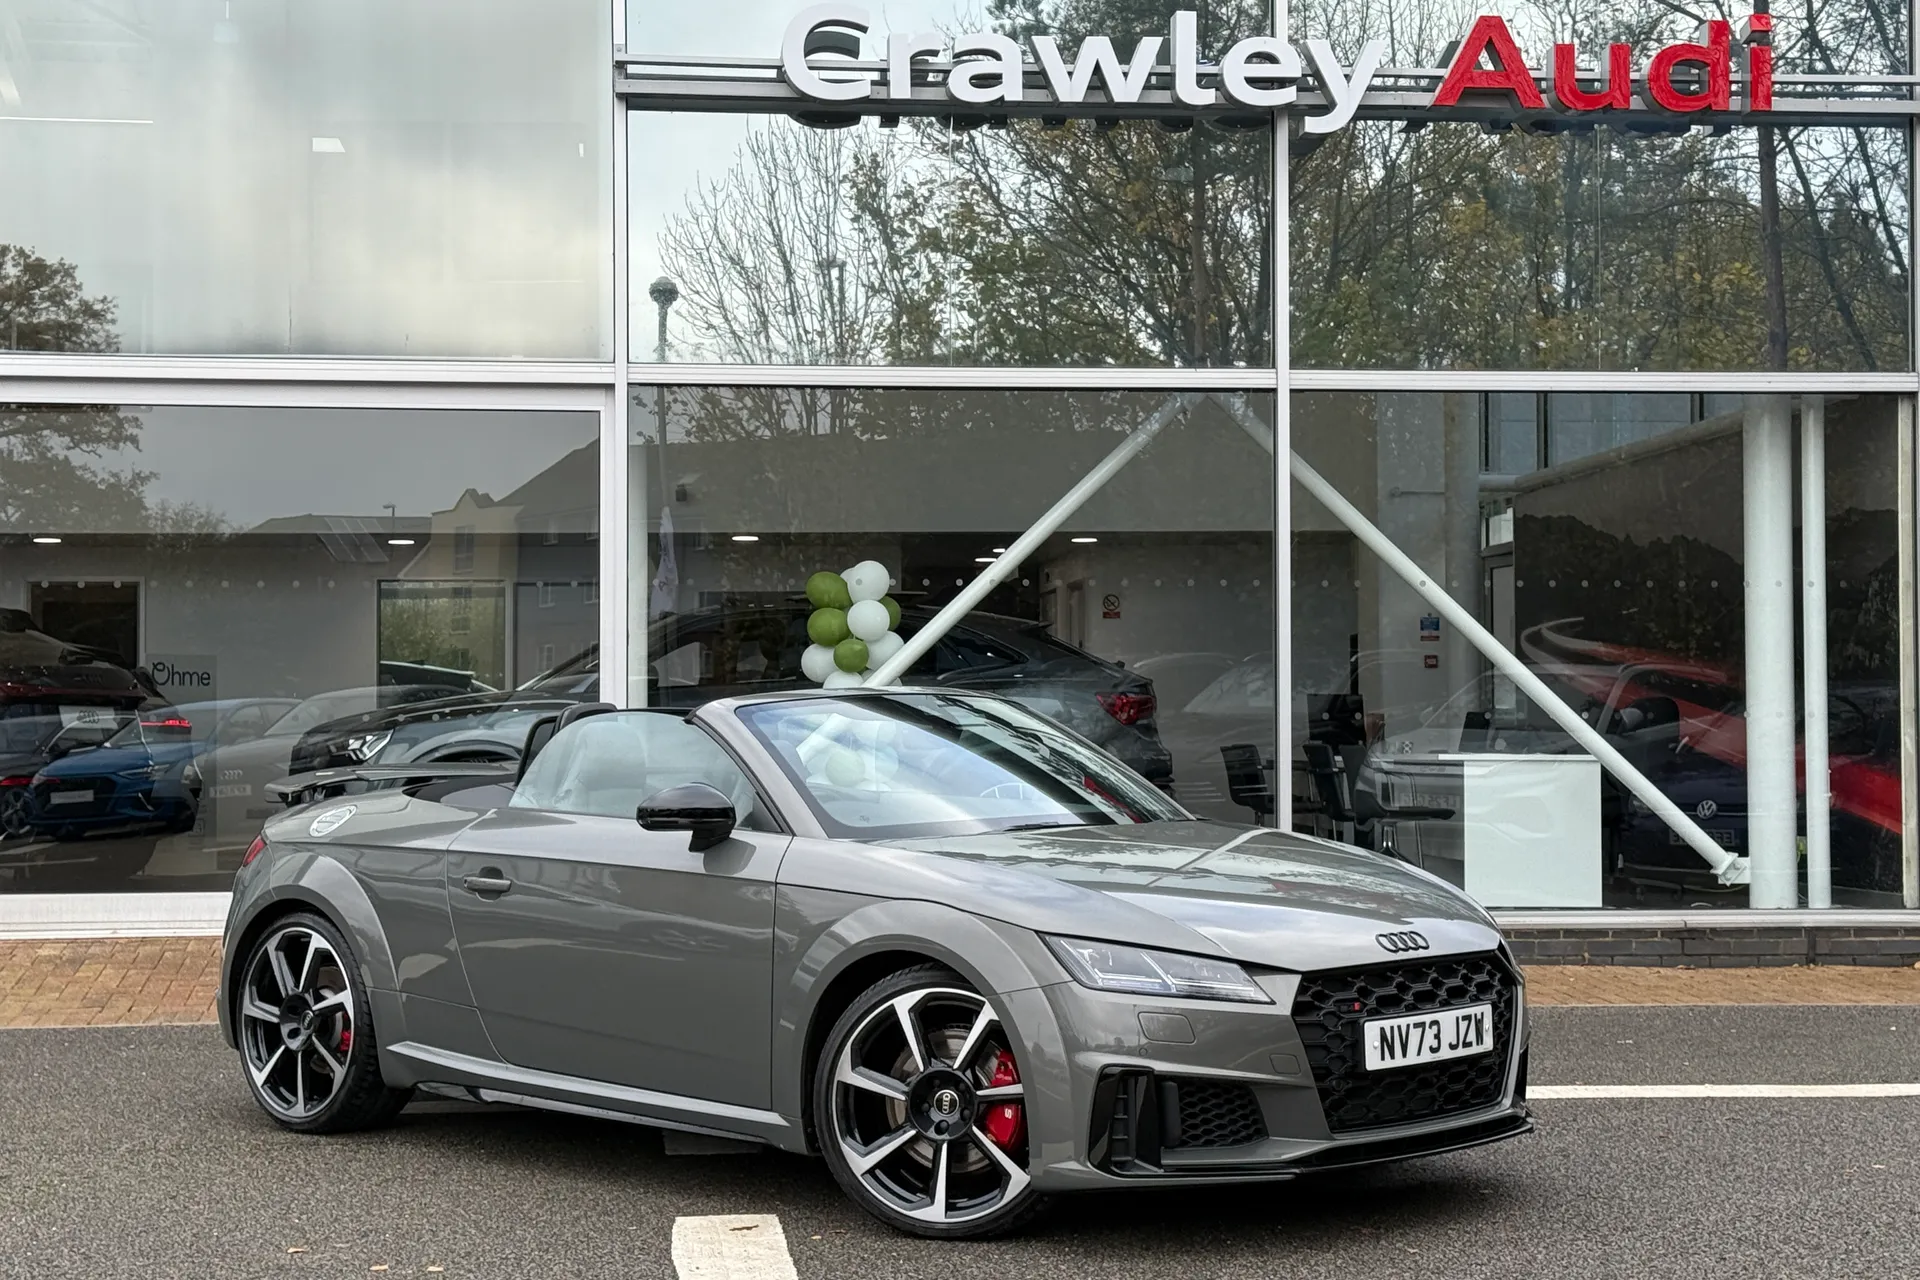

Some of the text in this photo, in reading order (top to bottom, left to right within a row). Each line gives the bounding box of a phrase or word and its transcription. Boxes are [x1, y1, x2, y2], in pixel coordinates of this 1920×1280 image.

[781, 2, 1773, 134] Crawley Audi
[152, 662, 211, 687] Ohme
[1380, 1011, 1485, 1061] NV73 JZW
